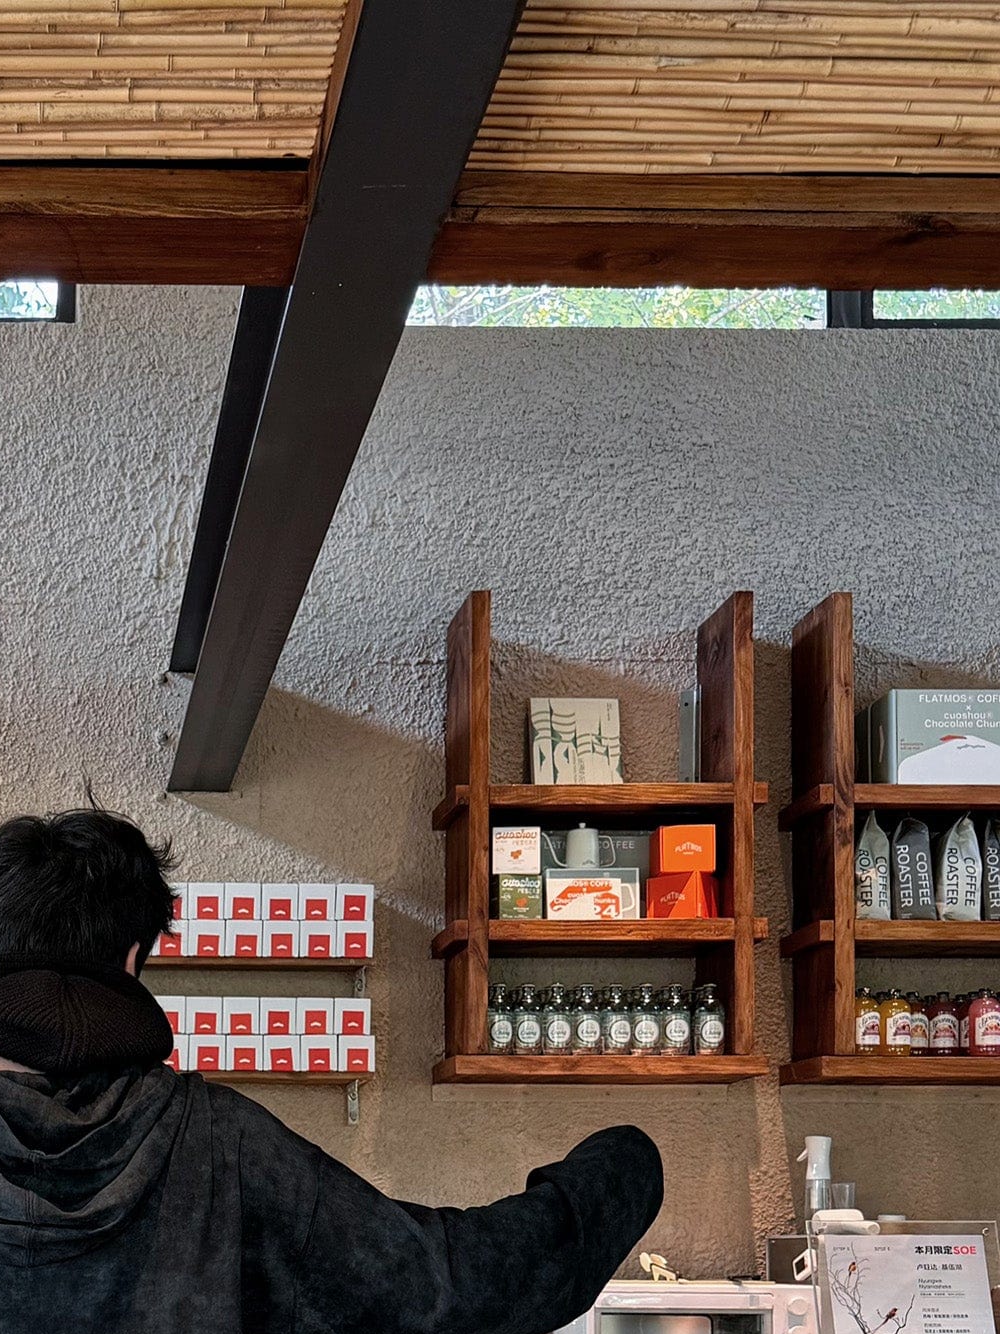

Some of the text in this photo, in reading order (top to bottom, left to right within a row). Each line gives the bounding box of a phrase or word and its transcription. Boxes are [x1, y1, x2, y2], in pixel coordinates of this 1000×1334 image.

[924, 719, 974, 728] Chocolate
[859, 848, 873, 908] ROASTER
[875, 856, 889, 908] COFFEE
[896, 844, 914, 908] ROASTER
[916, 852, 931, 906] COFFEE
[946, 847, 959, 905] ROASTER
[964, 856, 977, 907] COFFEE
[986, 847, 1000, 908] ROASTER
